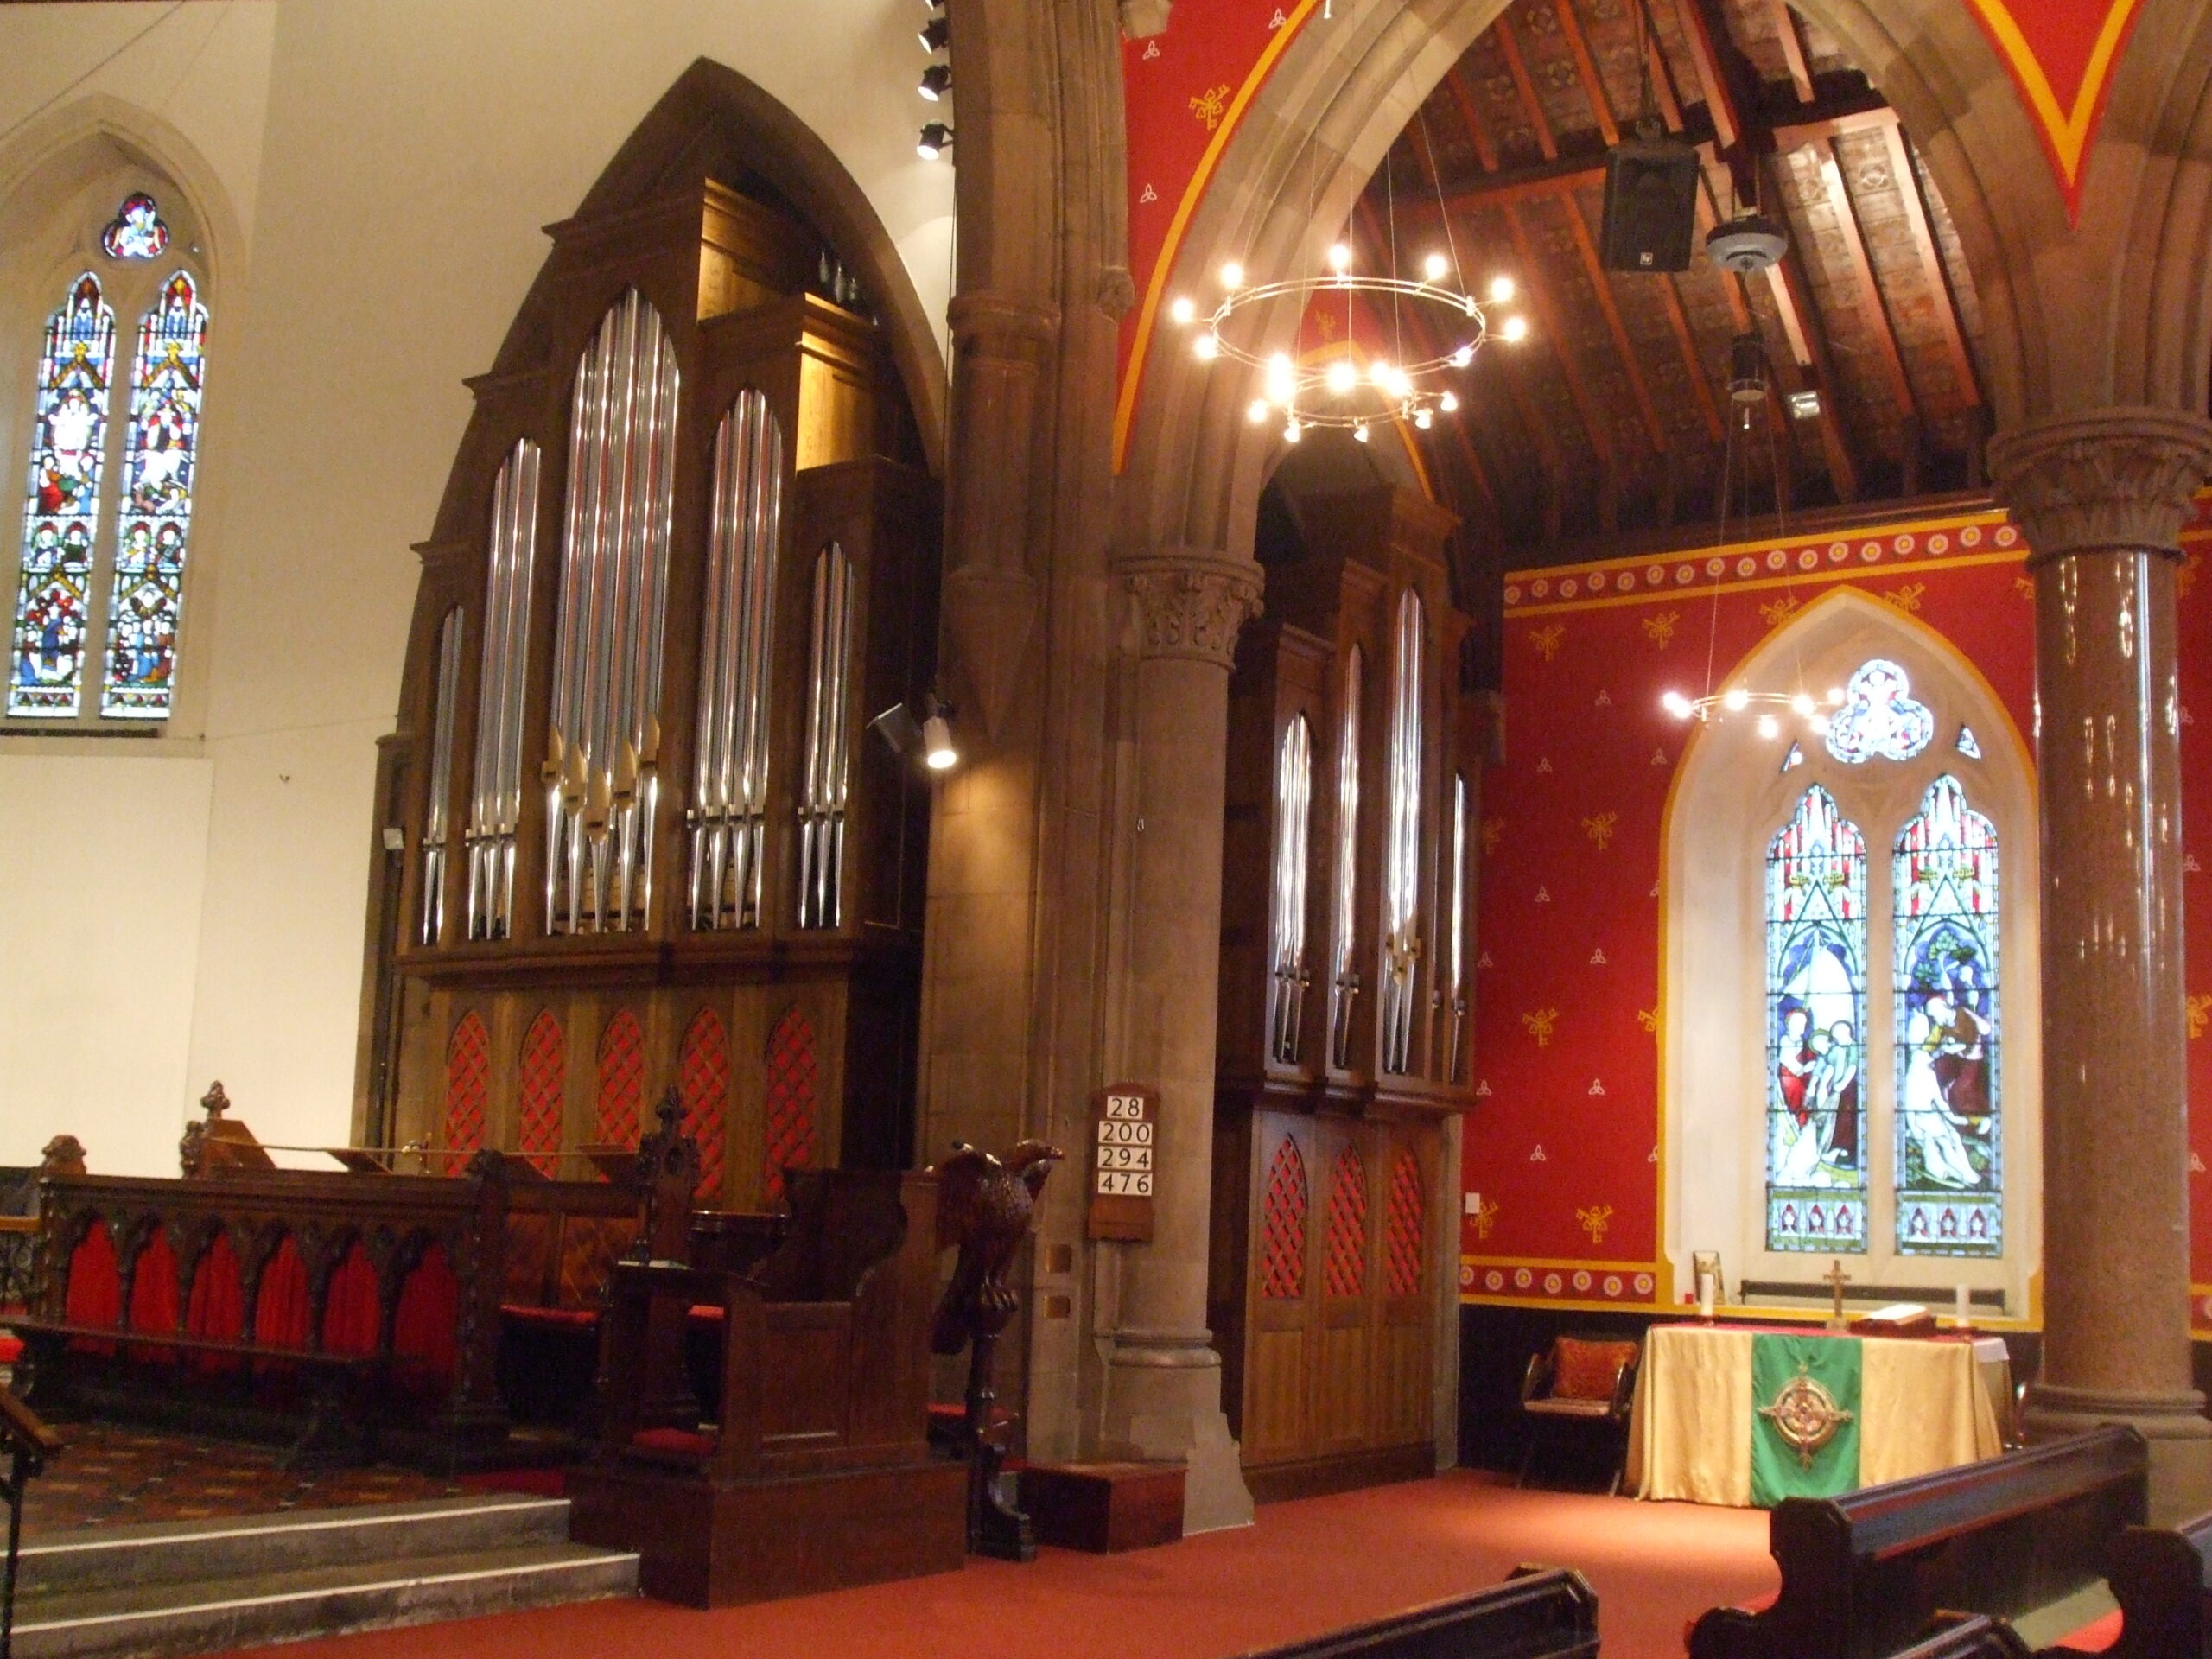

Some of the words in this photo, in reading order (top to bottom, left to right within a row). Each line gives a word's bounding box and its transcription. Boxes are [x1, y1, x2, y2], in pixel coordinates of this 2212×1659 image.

[1111, 1098, 1139, 1116] 28
[1103, 1122, 1150, 1142] 200
[1102, 1148, 1149, 1167] 294
[1102, 1174, 1149, 1192] 476
